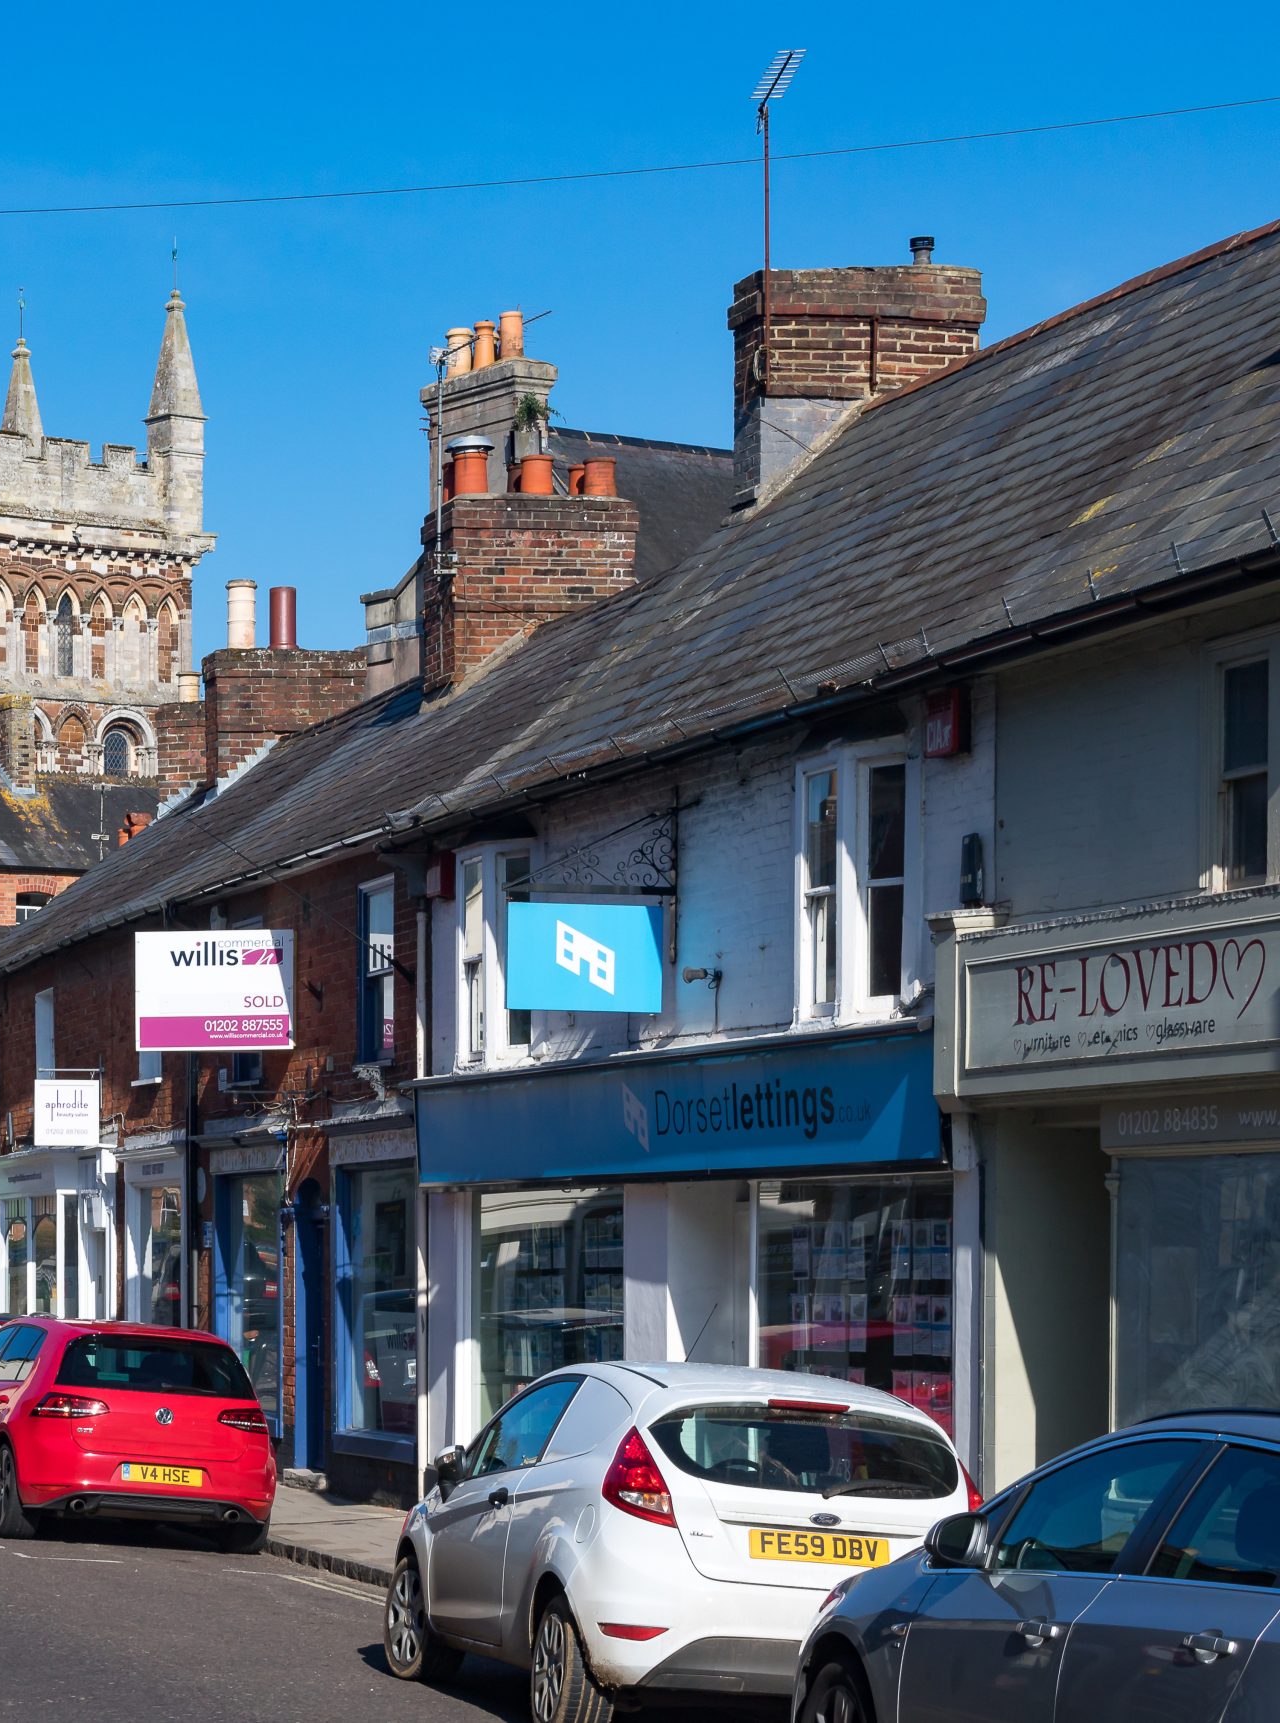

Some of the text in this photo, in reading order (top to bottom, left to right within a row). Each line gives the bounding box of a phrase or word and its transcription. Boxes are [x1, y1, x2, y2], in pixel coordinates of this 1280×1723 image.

[170, 941, 238, 966] willis
[218, 937, 283, 948] commercial
[1013, 940, 1217, 1024] RE-LOVED
[244, 995, 283, 1008] SOLD
[204, 1019, 283, 1031] 01202 887555
[45, 1089, 88, 1121] aphrodite
[1118, 1110, 1159, 1136] 01202
[141, 1467, 190, 1483] V4 HSE
[760, 1532, 878, 1562] FE59 DBV
